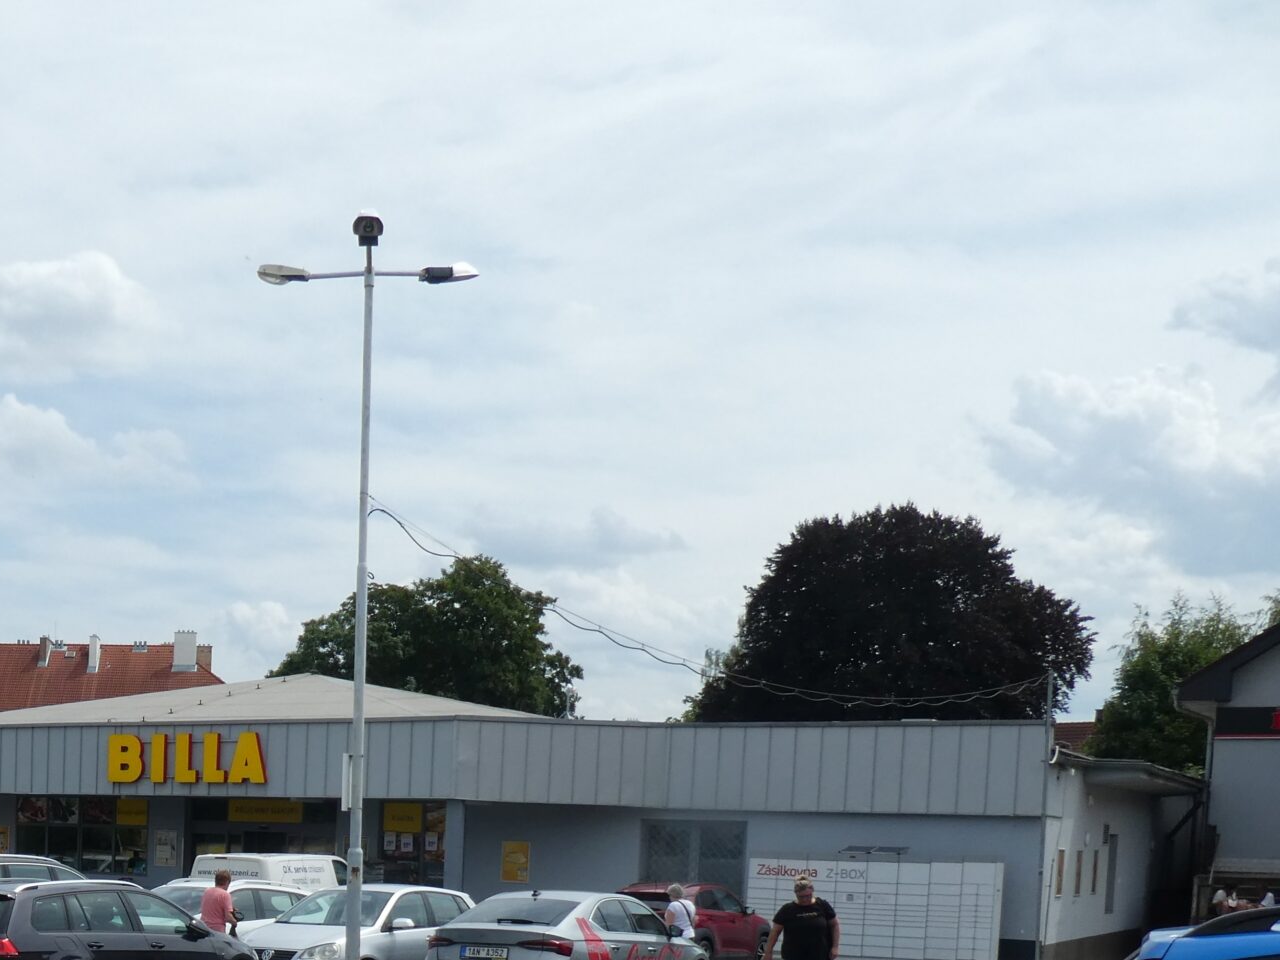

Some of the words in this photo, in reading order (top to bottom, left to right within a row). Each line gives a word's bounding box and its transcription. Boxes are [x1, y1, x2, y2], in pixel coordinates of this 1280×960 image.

[108, 731, 267, 784] BILLA
[757, 863, 818, 878] Zásilkovna
[825, 868, 866, 880] Z-BOX
